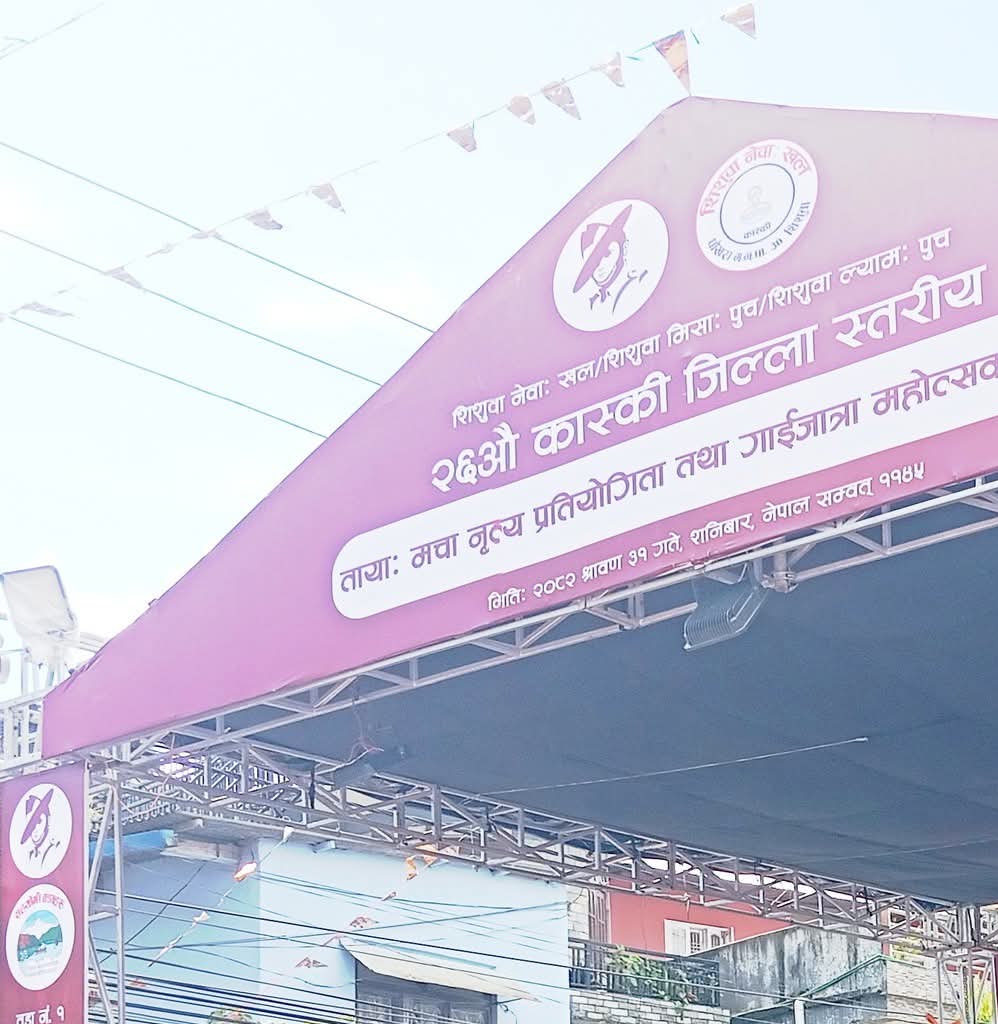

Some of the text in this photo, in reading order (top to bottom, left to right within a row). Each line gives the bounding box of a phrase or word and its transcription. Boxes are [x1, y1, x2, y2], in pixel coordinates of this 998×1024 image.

[452, 227, 951, 431] शिशुवा नेवा: खल/शिशुवा मिसा: पुच/शिशुवा ल्याम: पुच
[531, 371, 671, 456] कास्की
[683, 324, 818, 404] जिल्ला
[831, 265, 987, 348] स्तरीय
[339, 554, 399, 593] ताया:
[409, 532, 460, 569] मचा
[532, 461, 667, 534] प्रतियोगिता
[674, 439, 730, 479] तथा
[738, 397, 862, 459] गाईजात्रा
[533, 572, 576, 597] २०८२
[581, 554, 623, 582] श्रावण
[628, 547, 647, 567] ३१
[761, 495, 811, 522] नेपाल
[815, 477, 874, 507] सम्वत्
[879, 462, 924, 487] ११४५
[56, 1005, 66, 1021] १
